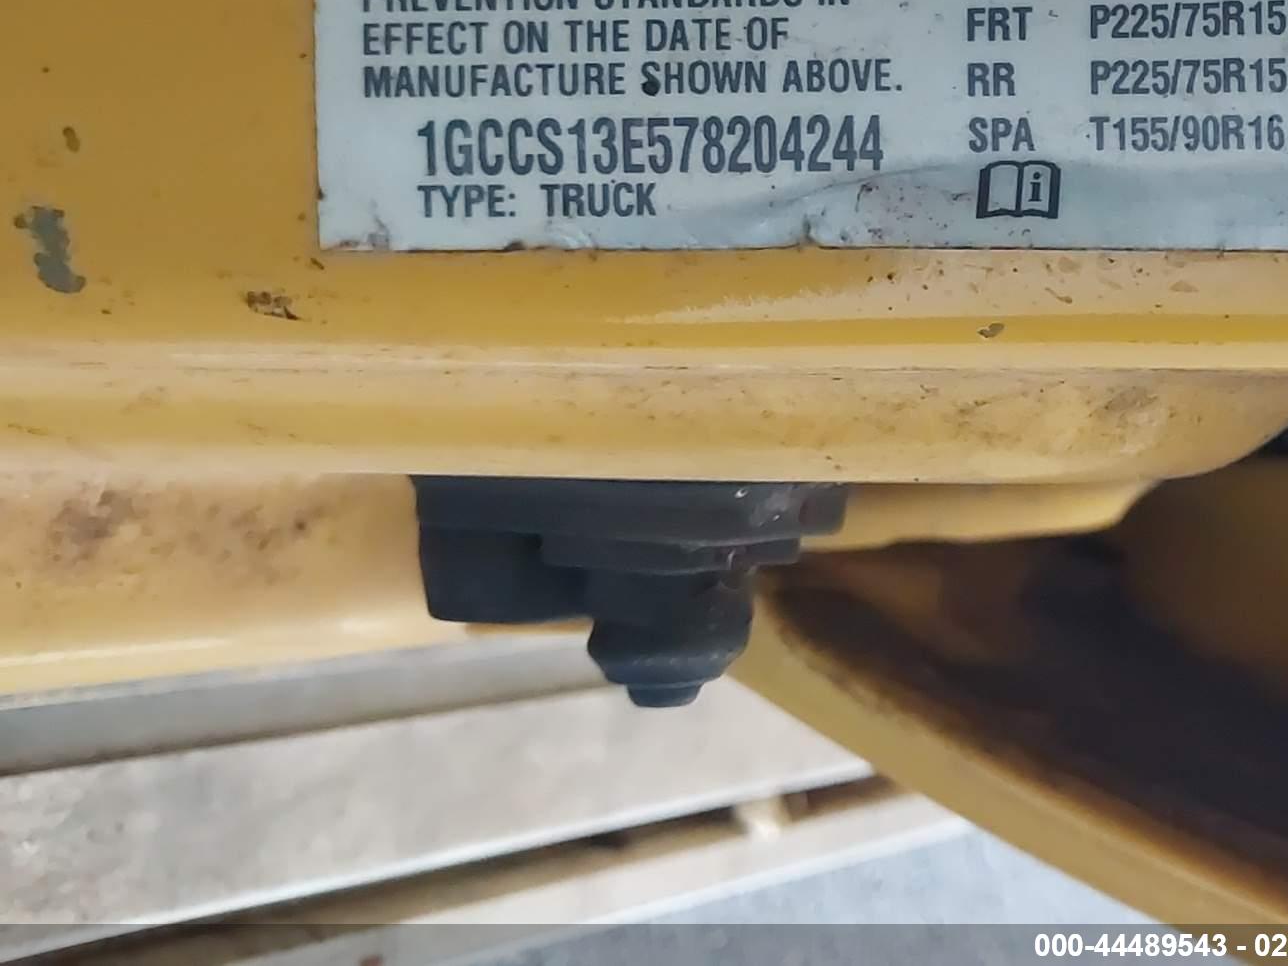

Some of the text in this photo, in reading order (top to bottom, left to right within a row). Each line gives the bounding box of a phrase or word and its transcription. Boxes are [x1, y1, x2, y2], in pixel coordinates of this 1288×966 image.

[363, 17, 789, 55] EFFECT ON THE DATE OF
[967, 7, 1032, 41] FRT
[1090, 0, 1286, 39] P225/75R15
[364, 59, 902, 98] MANUFACTURE SHOWN ABOVE.
[968, 62, 1016, 97] RR
[1091, 58, 1287, 98] P225/75R15
[418, 114, 883, 176] 1GCCS13E578204244
[969, 117, 1035, 153] SPA
[1089, 115, 1284, 151] T155/90R16
[418, 182, 656, 218] TYPE: TRUCK
